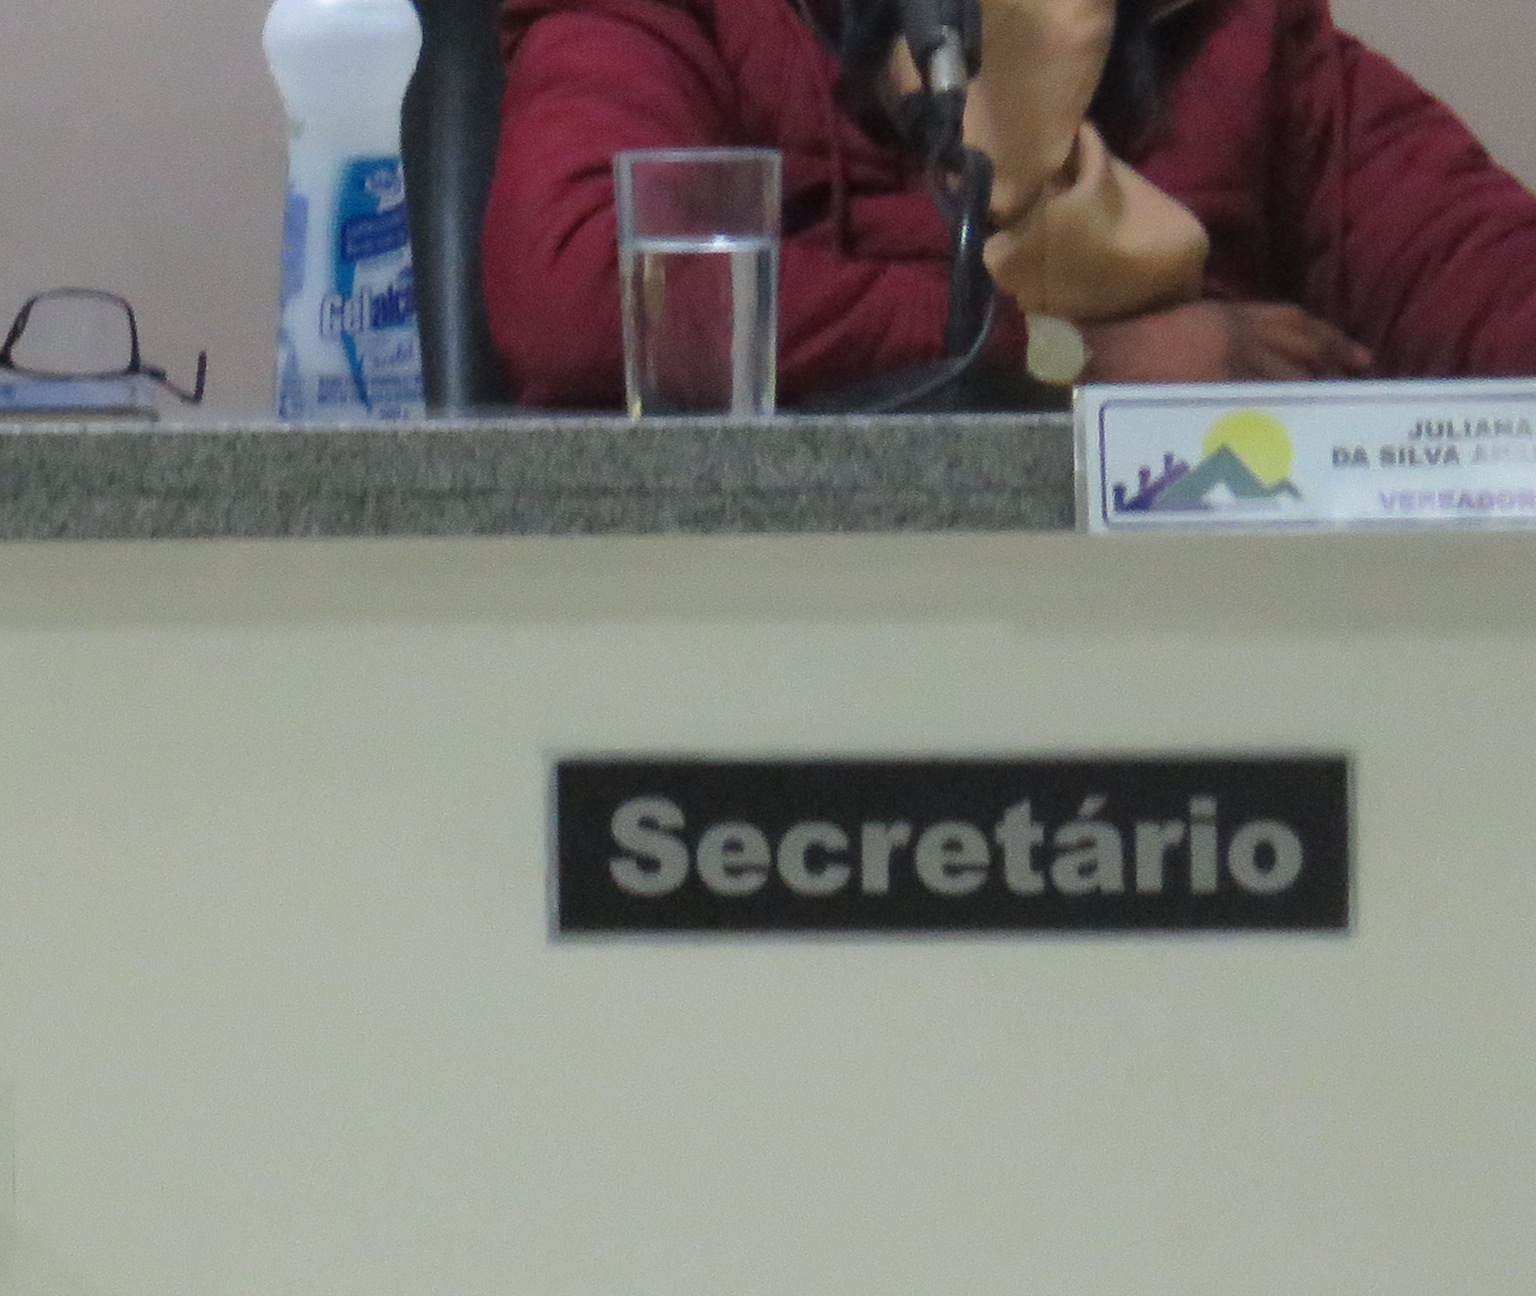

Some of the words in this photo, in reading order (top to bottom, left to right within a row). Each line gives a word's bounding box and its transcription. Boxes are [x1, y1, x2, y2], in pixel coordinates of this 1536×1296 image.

[1407, 418, 1533, 441] JULIANA
[1332, 446, 1369, 467] DA
[1379, 444, 1460, 467] SILVA
[608, 794, 1303, 897] Secretário
